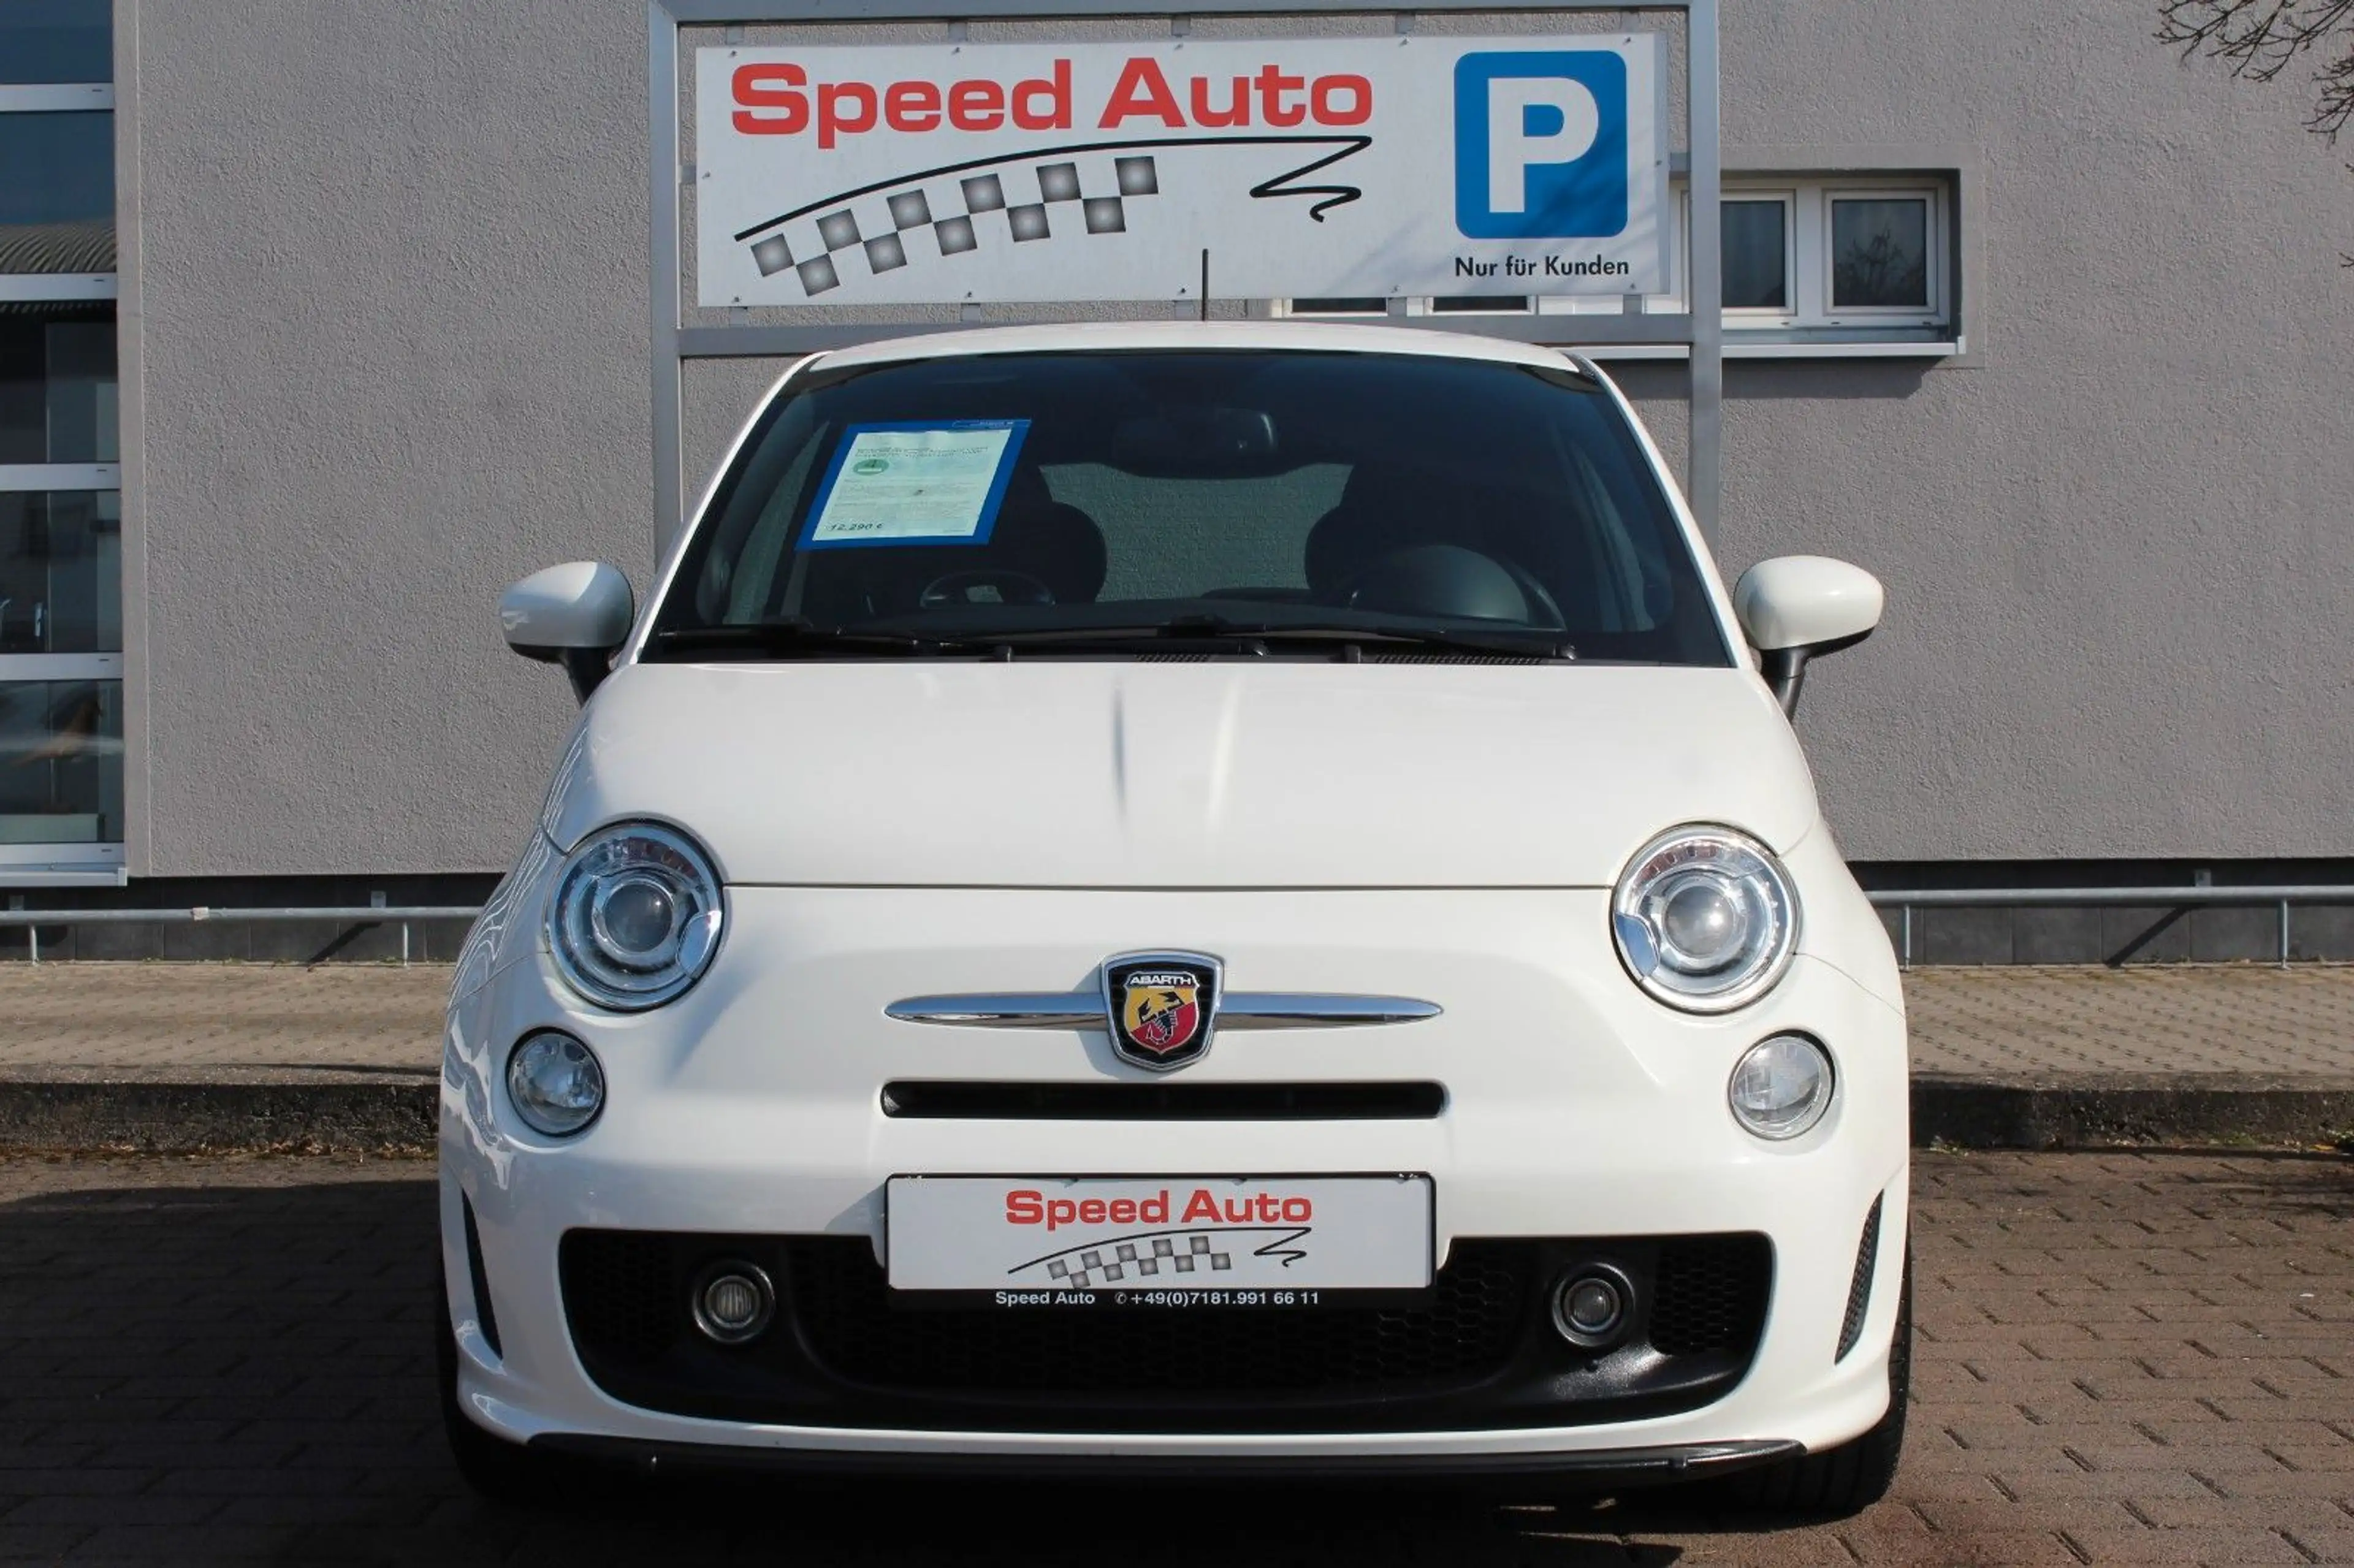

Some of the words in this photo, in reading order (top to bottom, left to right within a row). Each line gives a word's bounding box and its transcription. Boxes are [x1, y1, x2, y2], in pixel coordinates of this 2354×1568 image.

[733, 59, 1072, 149] Speed
[1099, 58, 1372, 129] Auto
[1488, 77, 1599, 213] P
[1455, 256, 1498, 277] Nur
[1505, 254, 1537, 276] für
[1545, 254, 1629, 276] Kunden
[1130, 975, 1192, 986] ABARTH
[1006, 1189, 1169, 1231] Speed
[1181, 1189, 1312, 1224] Auto
[995, 1291, 1050, 1307] Speed
[1054, 1291, 1096, 1305] Auto
[1130, 1291, 1266, 1307] +49(0)7181.991
[1273, 1291, 1295, 1304] 66
[1300, 1291, 1318, 1304] 11
